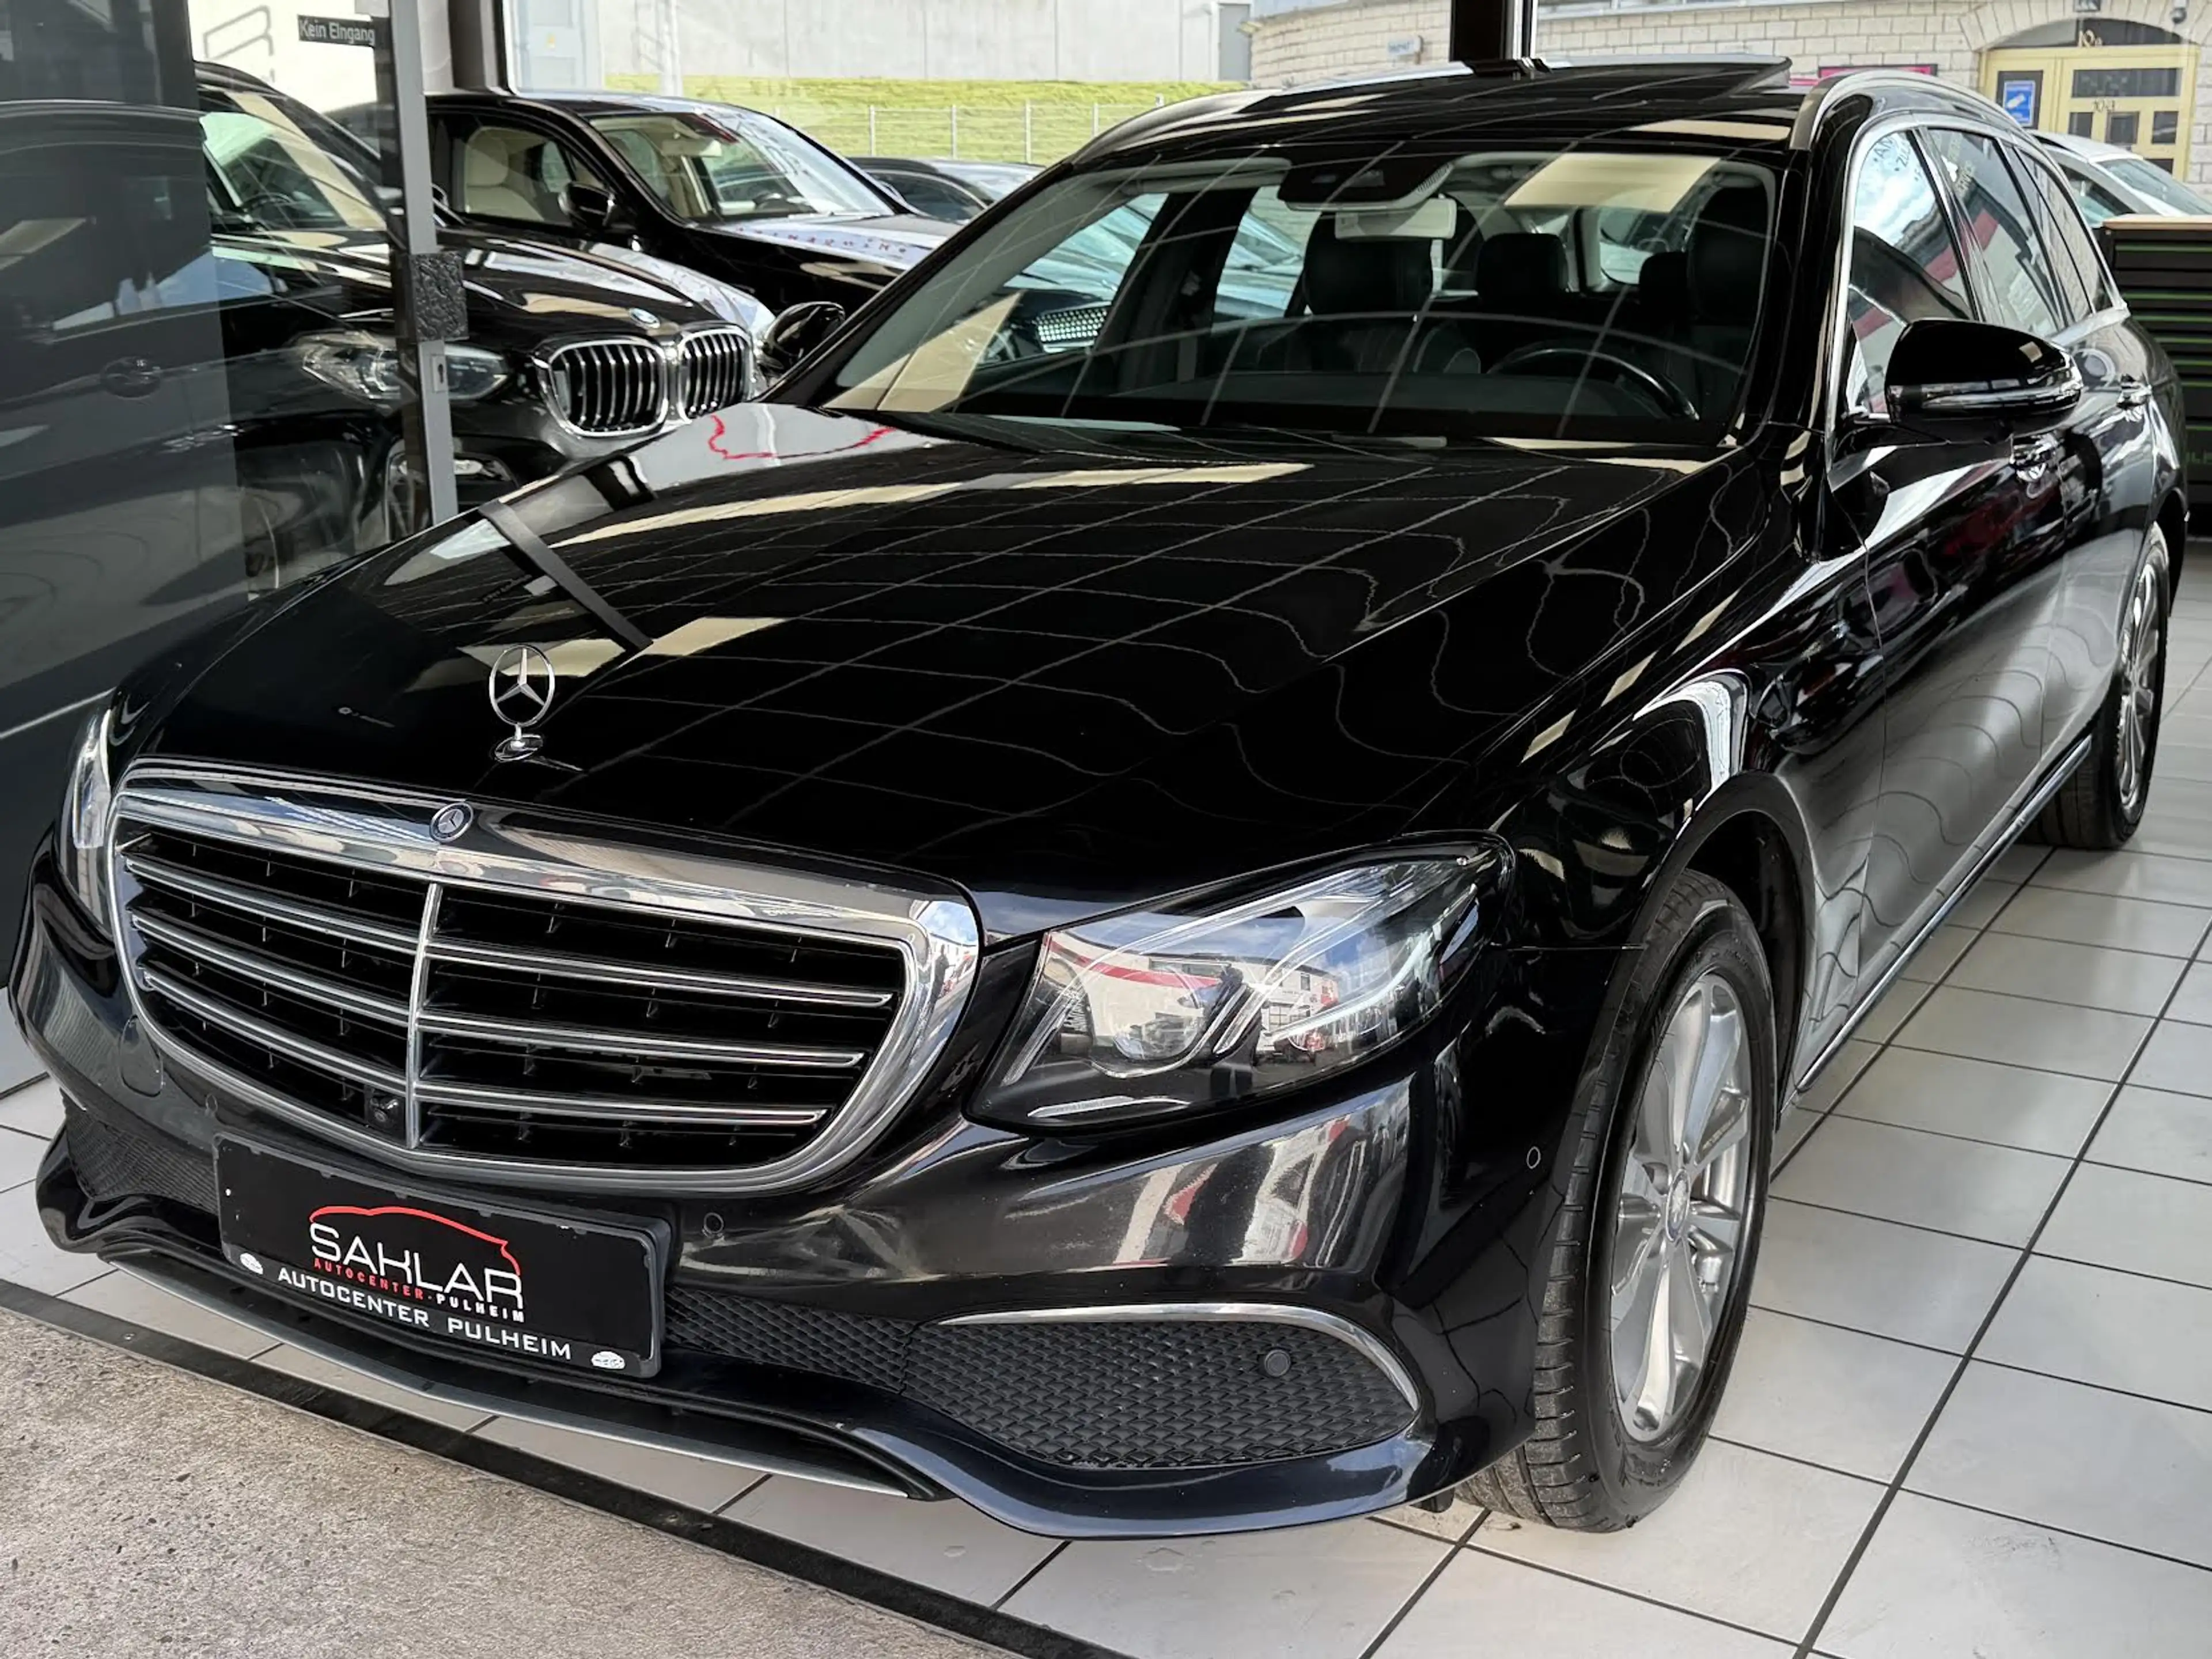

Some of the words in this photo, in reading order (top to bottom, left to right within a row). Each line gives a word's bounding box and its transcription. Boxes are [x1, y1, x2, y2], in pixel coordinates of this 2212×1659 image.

[299, 18, 327, 37] Kein
[329, 21, 375, 46] Eingang
[310, 1222, 524, 1309] SAHLAR
[313, 1257, 424, 1301] AUTOCENTER
[436, 1293, 525, 1323] PULHEIM
[278, 1267, 430, 1328] AUTOCENTER
[447, 1316, 571, 1361] PULHEIM
